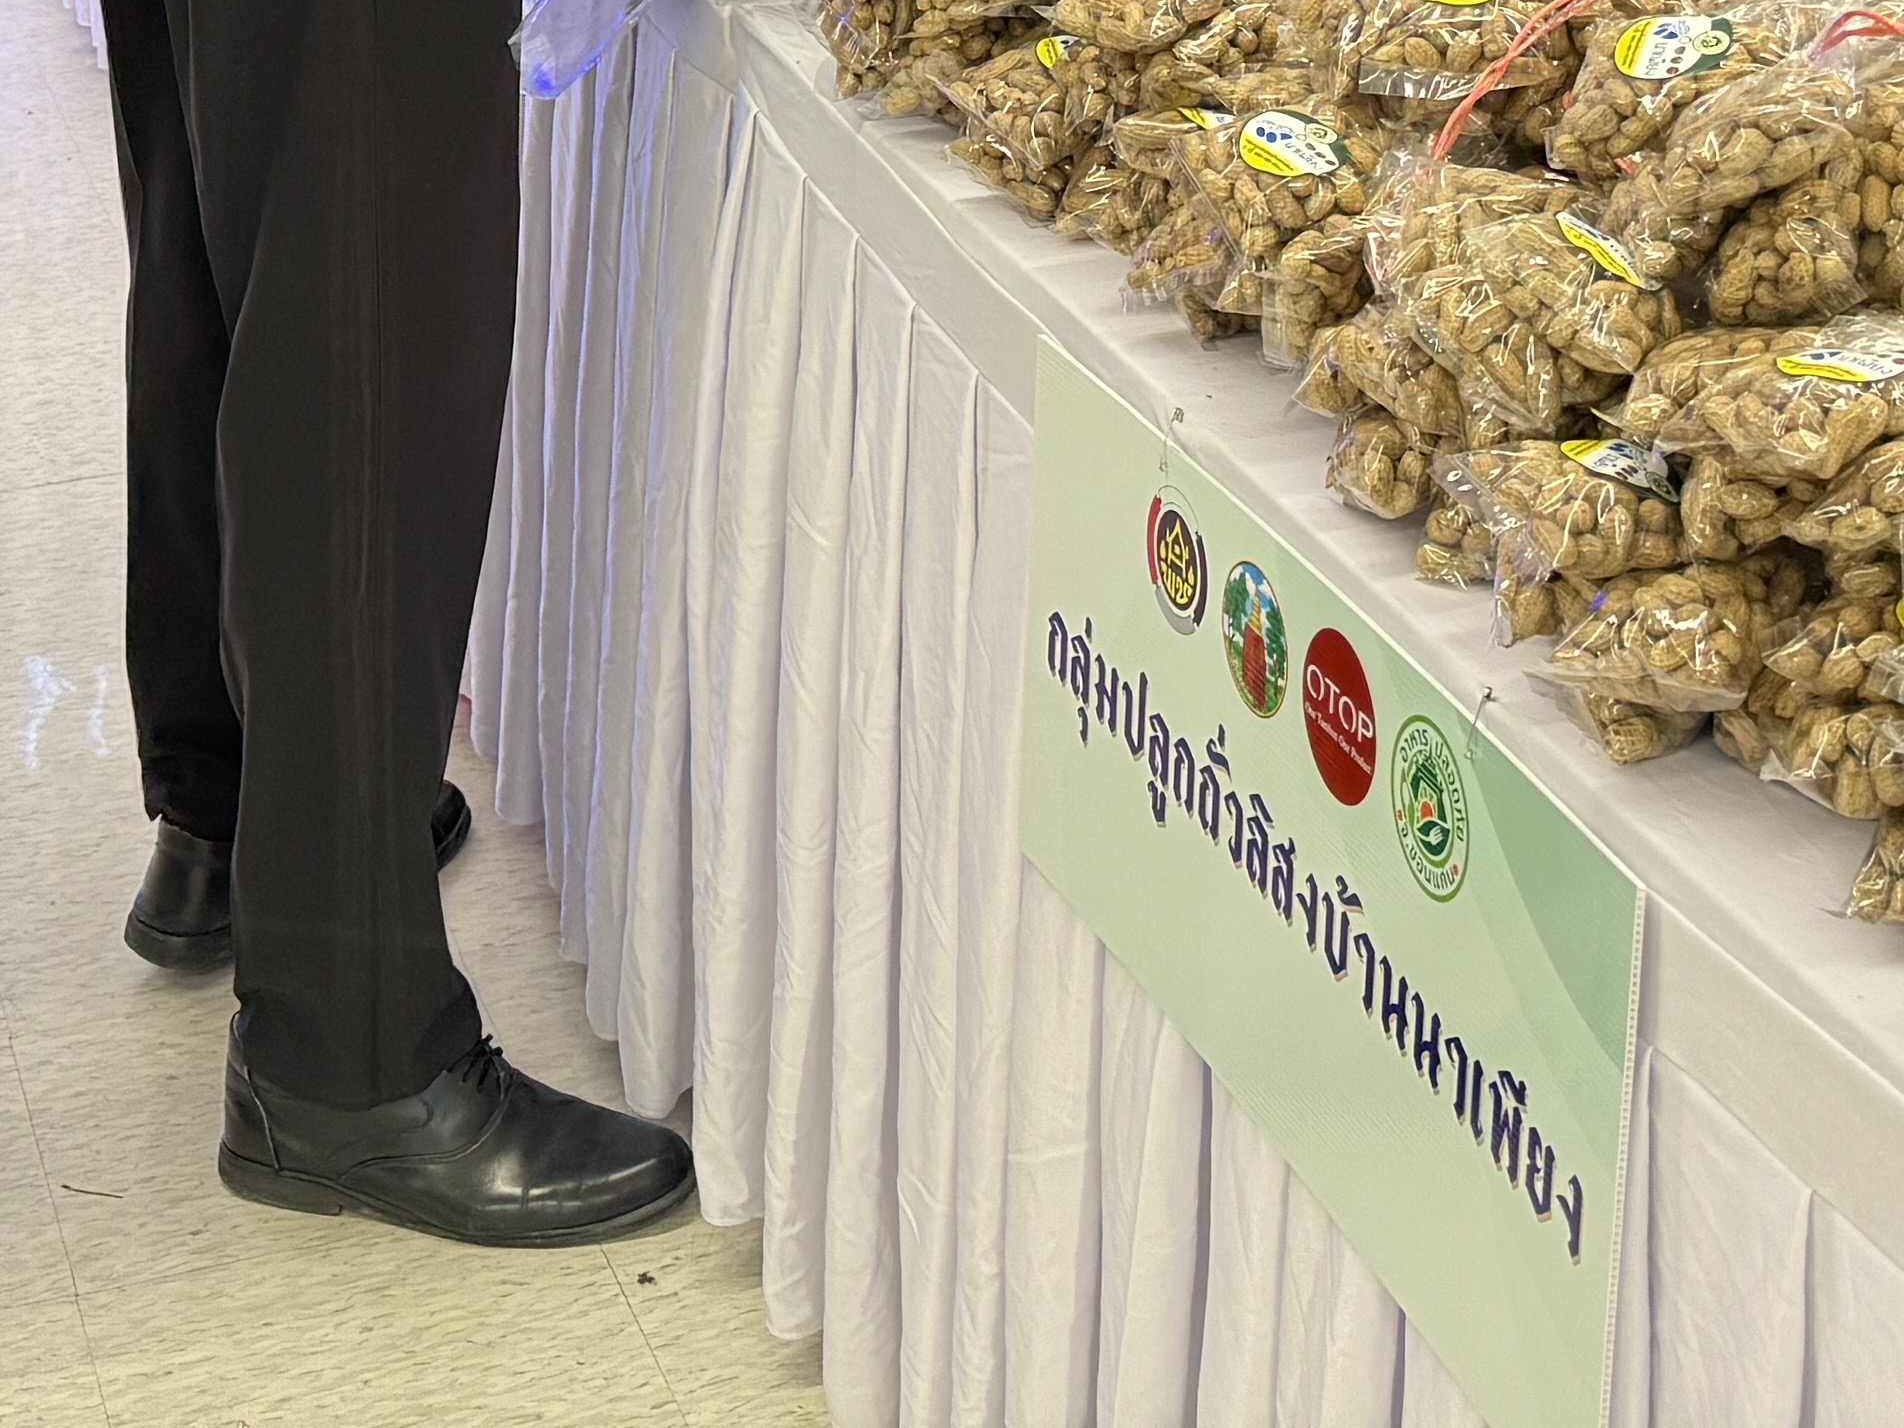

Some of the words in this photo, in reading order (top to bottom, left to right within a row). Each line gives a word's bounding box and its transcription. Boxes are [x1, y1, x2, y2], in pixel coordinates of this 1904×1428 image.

[1306, 663, 1374, 743] OTOP
[1047, 610, 1585, 1265] กลุ่มปลูกถั่วลิสงบ้านนาเพียง
